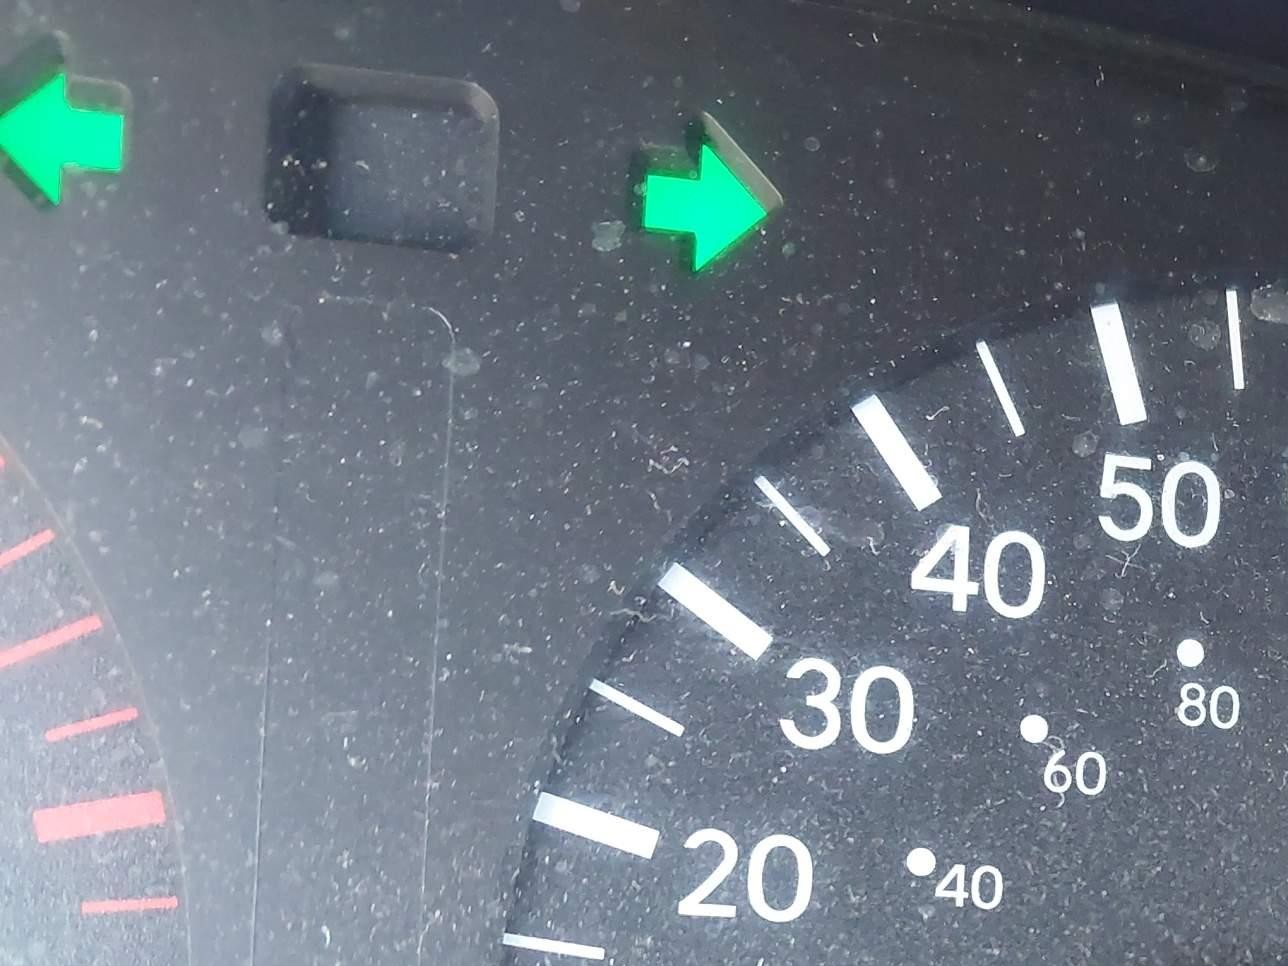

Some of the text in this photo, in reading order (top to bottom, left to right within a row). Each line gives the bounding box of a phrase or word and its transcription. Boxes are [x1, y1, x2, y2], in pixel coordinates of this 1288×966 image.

[1099, 453, 1220, 548] 50
[911, 524, 1045, 618] 40
[779, 657, 917, 754] 30
[1175, 683, 1239, 729] 80
[1044, 751, 1107, 800] 60
[678, 829, 812, 922] 20
[934, 865, 1004, 911] 40
